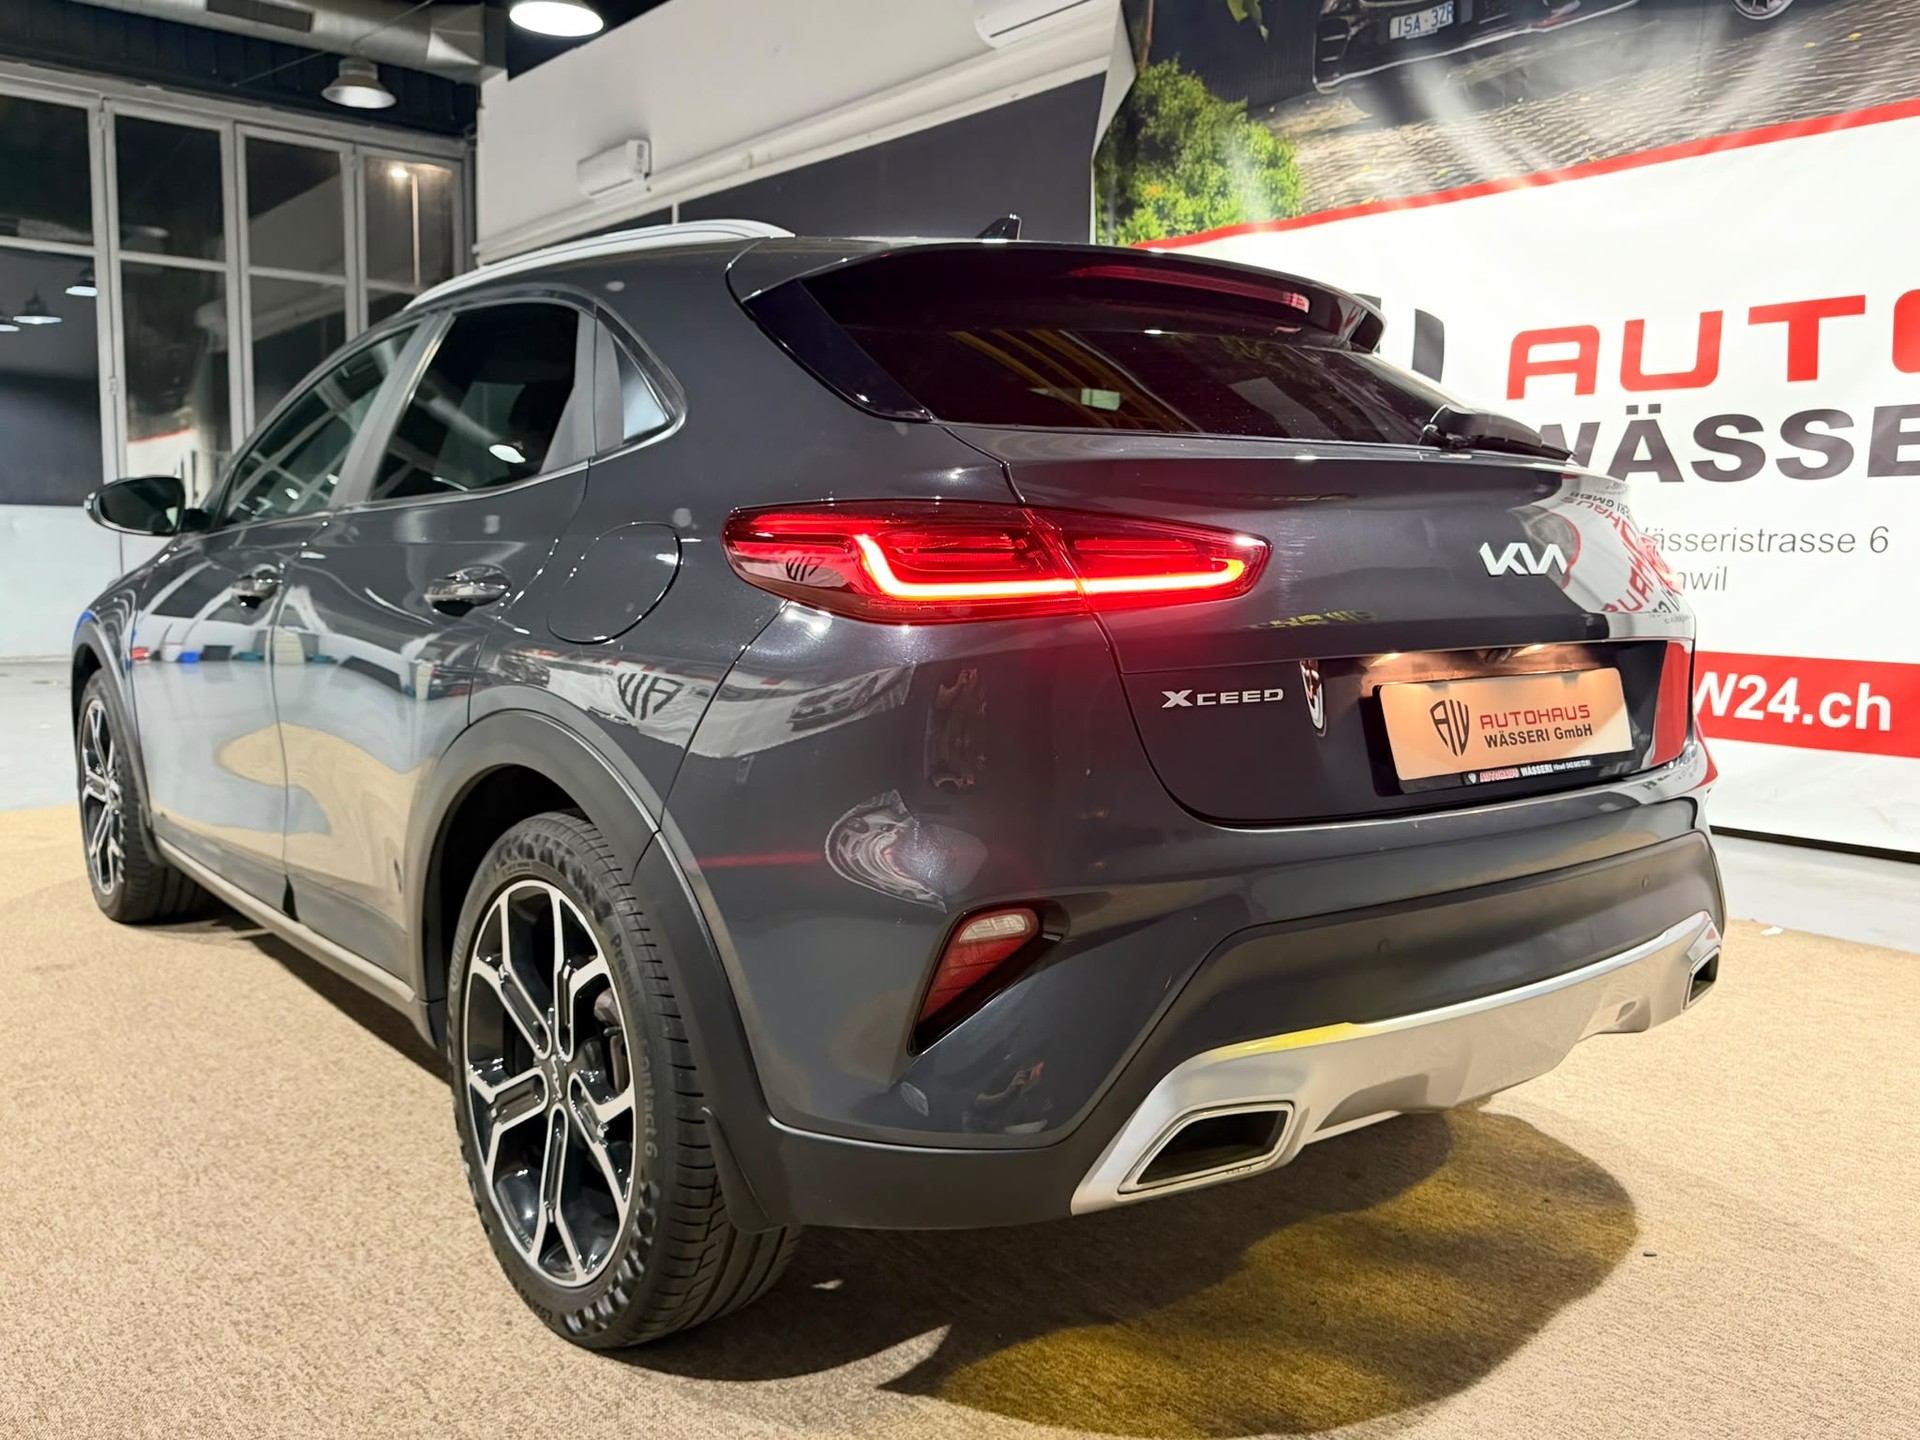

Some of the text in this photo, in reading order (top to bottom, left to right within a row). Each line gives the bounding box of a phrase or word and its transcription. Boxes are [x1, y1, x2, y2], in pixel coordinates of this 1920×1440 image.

[1644, 526, 1889, 553] ässeristrasse 6
[1478, 541, 1570, 576] KIA
[1480, 704, 1591, 730] AUTOHAUS
[1484, 723, 1593, 748] WÄSSERI GmbH
